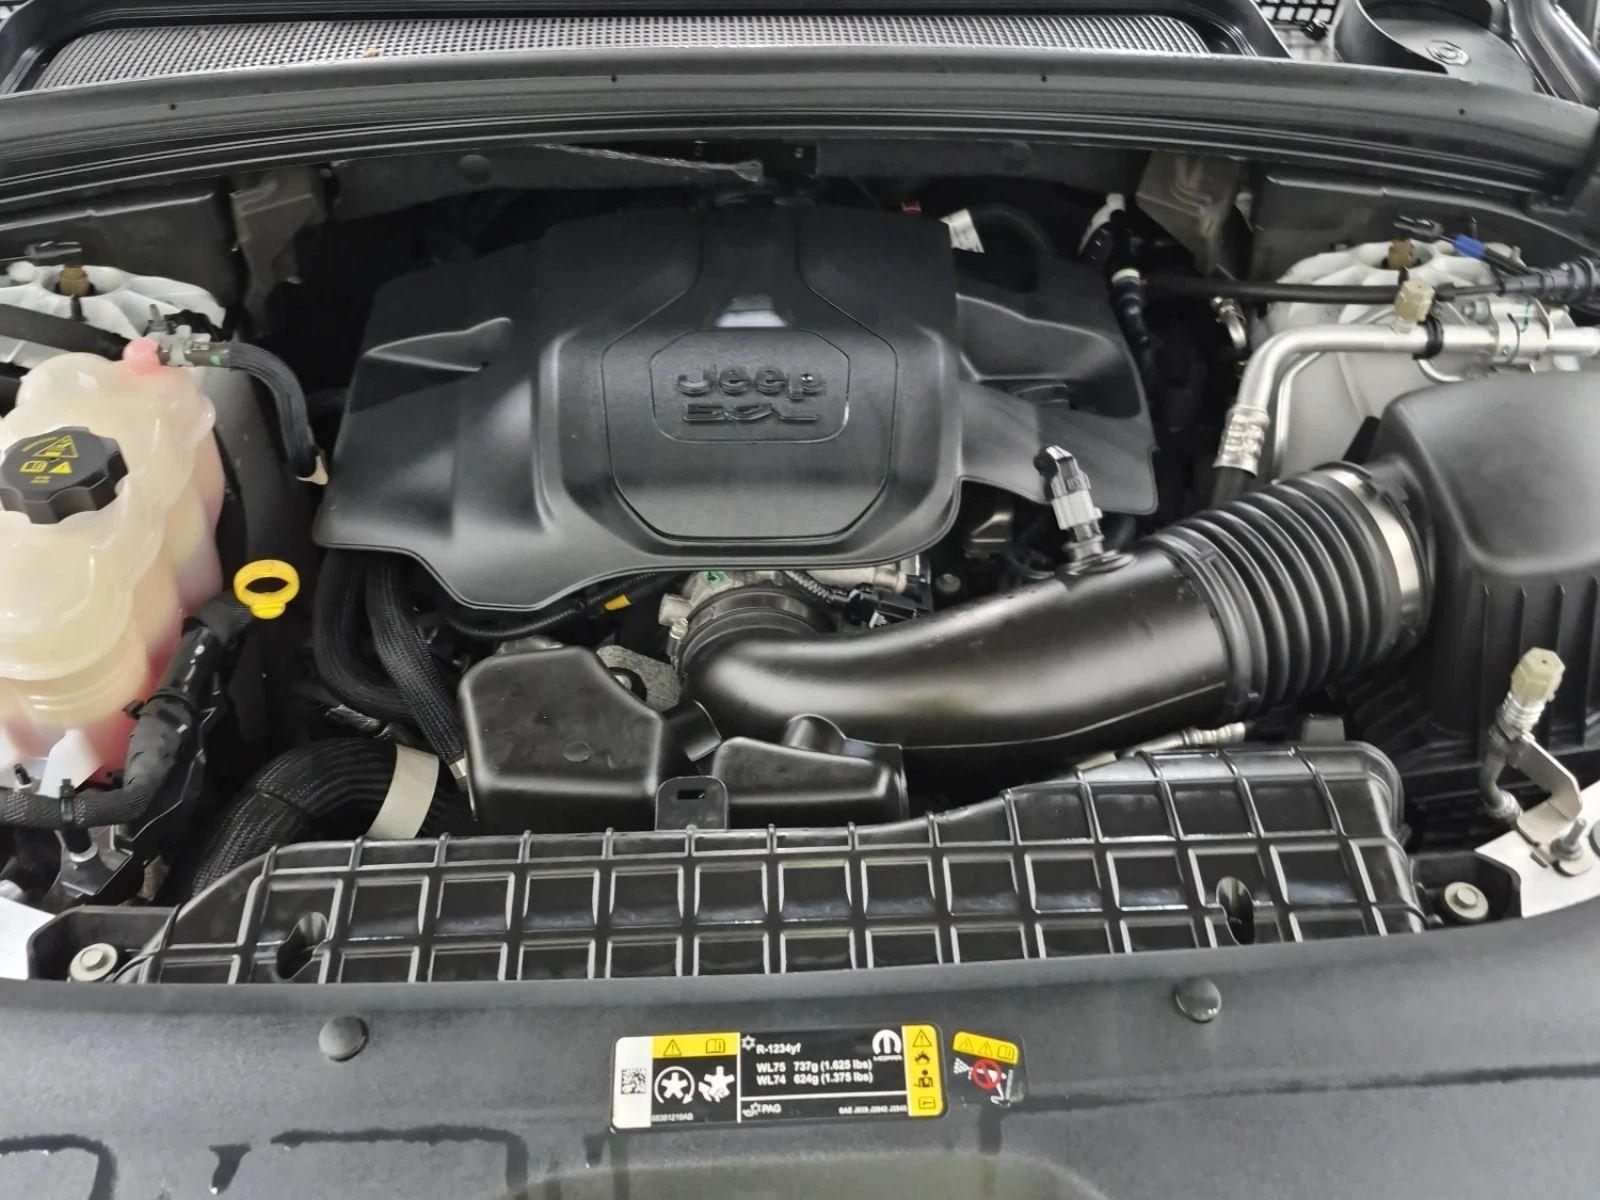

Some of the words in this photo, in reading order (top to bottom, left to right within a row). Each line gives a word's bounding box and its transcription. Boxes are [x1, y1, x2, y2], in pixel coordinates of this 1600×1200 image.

[676, 365, 826, 400] Jeep
[756, 1042, 801, 1055] R-1234yf
[756, 1062, 786, 1073] WL75
[793, 1061, 819, 1073] 737g
[820, 1060, 851, 1072] (1.625
[852, 1059, 873, 1071] lbs)
[756, 1074, 786, 1085] WL74
[793, 1073, 819, 1086] 624g
[820, 1072, 851, 1085] (1.375
[853, 1071, 873, 1083] lbs)
[762, 1104, 782, 1113] PAG
